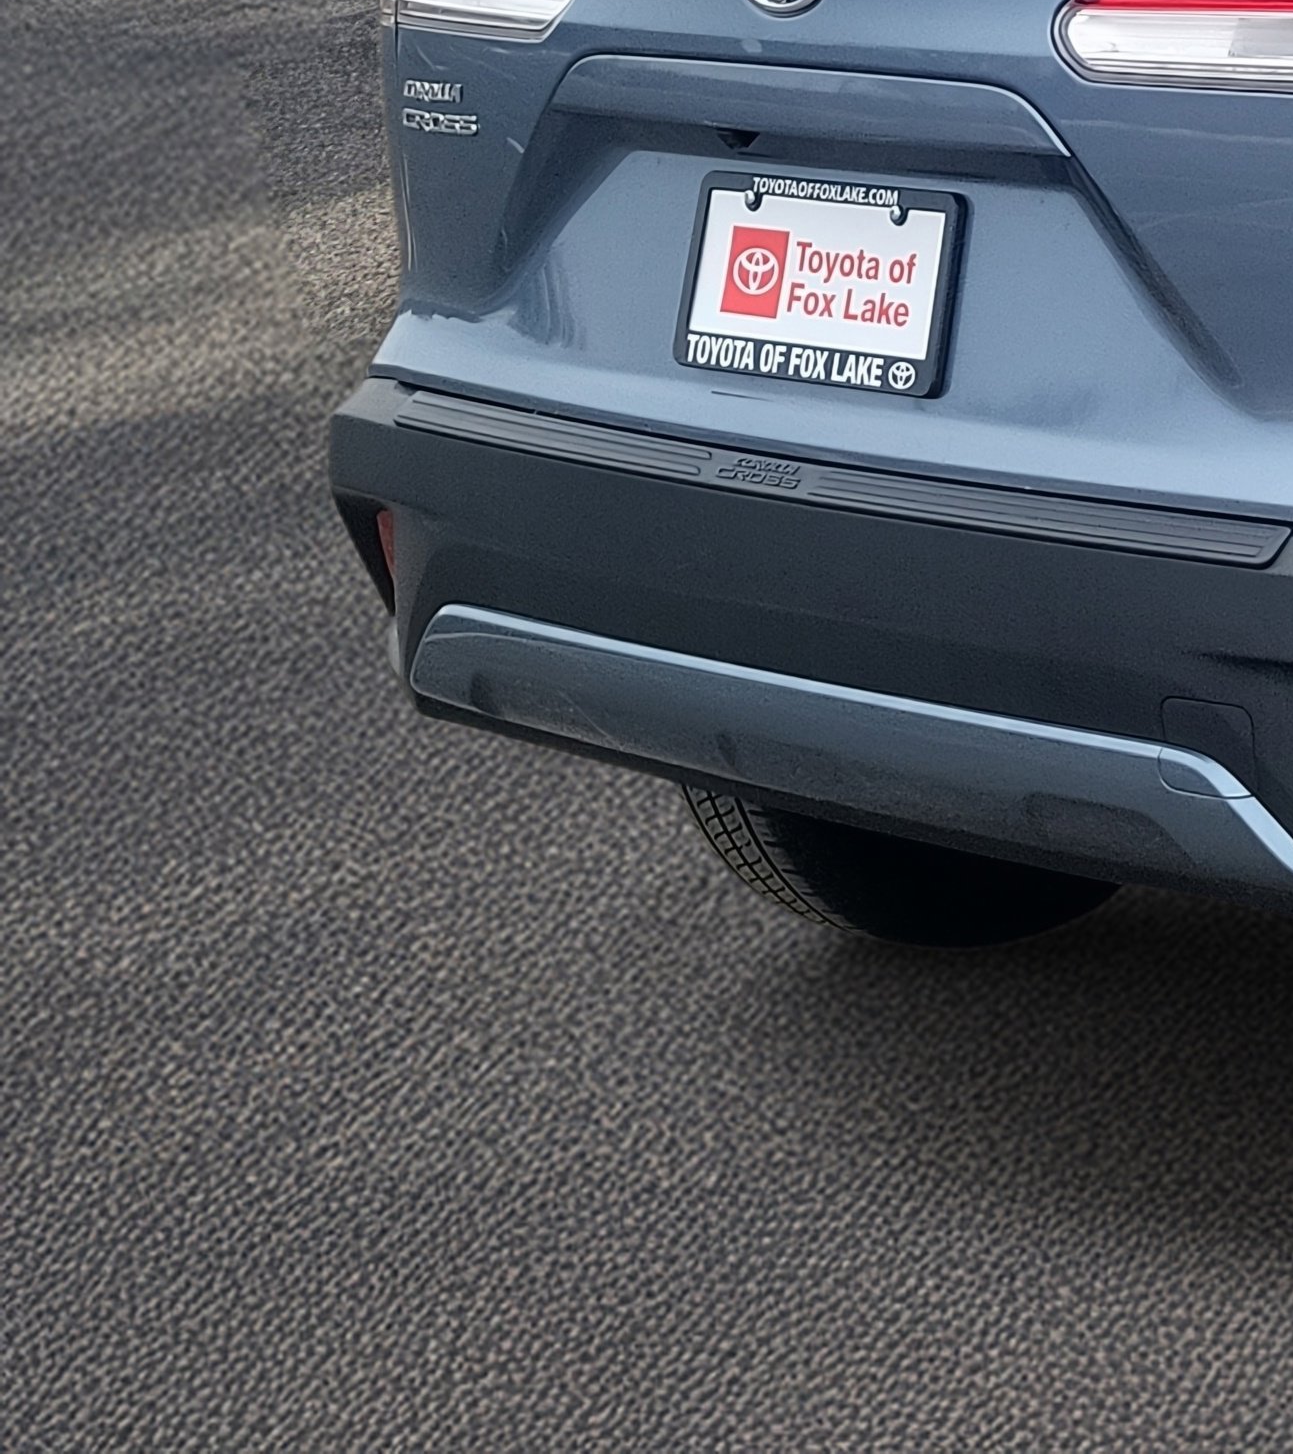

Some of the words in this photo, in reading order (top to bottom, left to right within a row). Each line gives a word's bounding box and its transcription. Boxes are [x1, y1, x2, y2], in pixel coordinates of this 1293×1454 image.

[752, 176, 899, 206] TOYOTAOFFOXLAKE.COM
[796, 241, 880, 284] Toyota
[889, 253, 917, 284] of
[786, 283, 836, 318] Fox
[843, 288, 909, 327] Lake
[686, 333, 755, 371] TOYOTA
[759, 343, 785, 374] OF
[788, 346, 828, 381] FOX
[831, 354, 884, 388] LAKE
